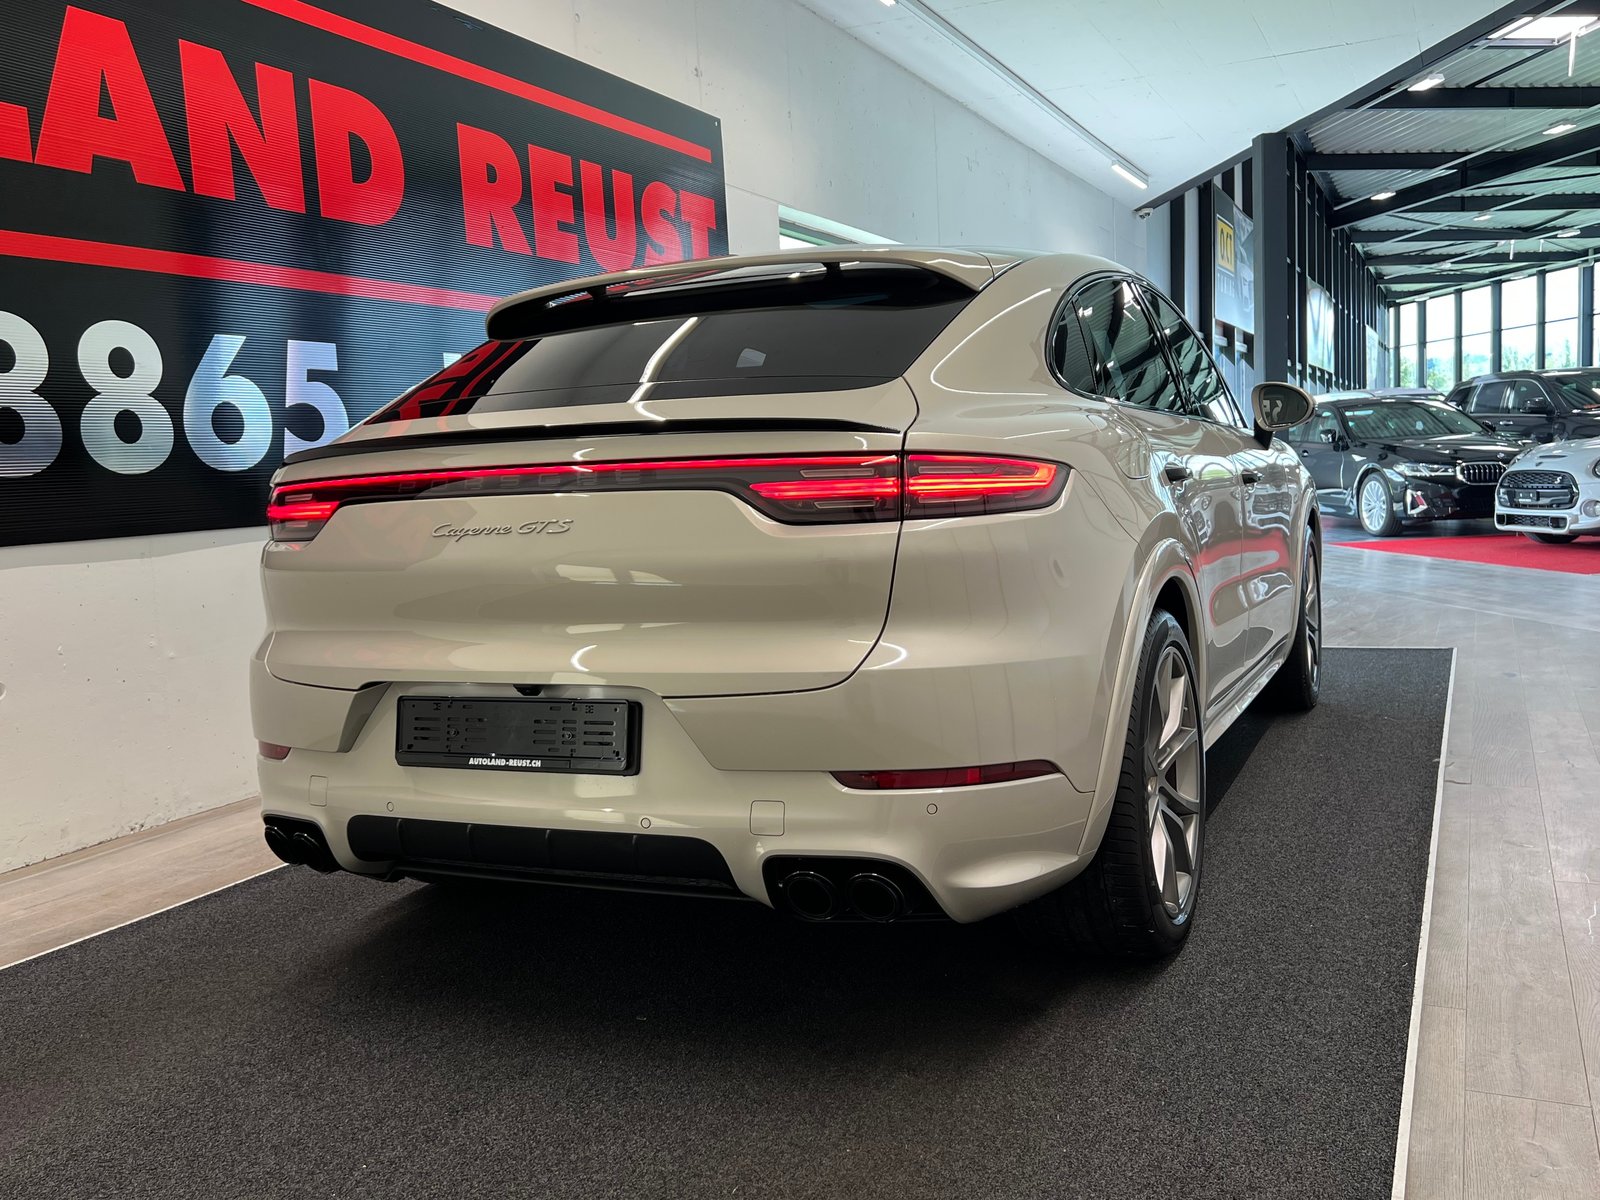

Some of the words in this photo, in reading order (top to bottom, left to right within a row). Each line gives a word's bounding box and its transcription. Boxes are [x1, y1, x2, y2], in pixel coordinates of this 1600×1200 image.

[456, 122, 716, 272] REUST
[431, 523, 513, 542] Cayenne
[517, 519, 575, 534] GTS
[468, 756, 542, 768] AUTOLAND-REUST.CH
